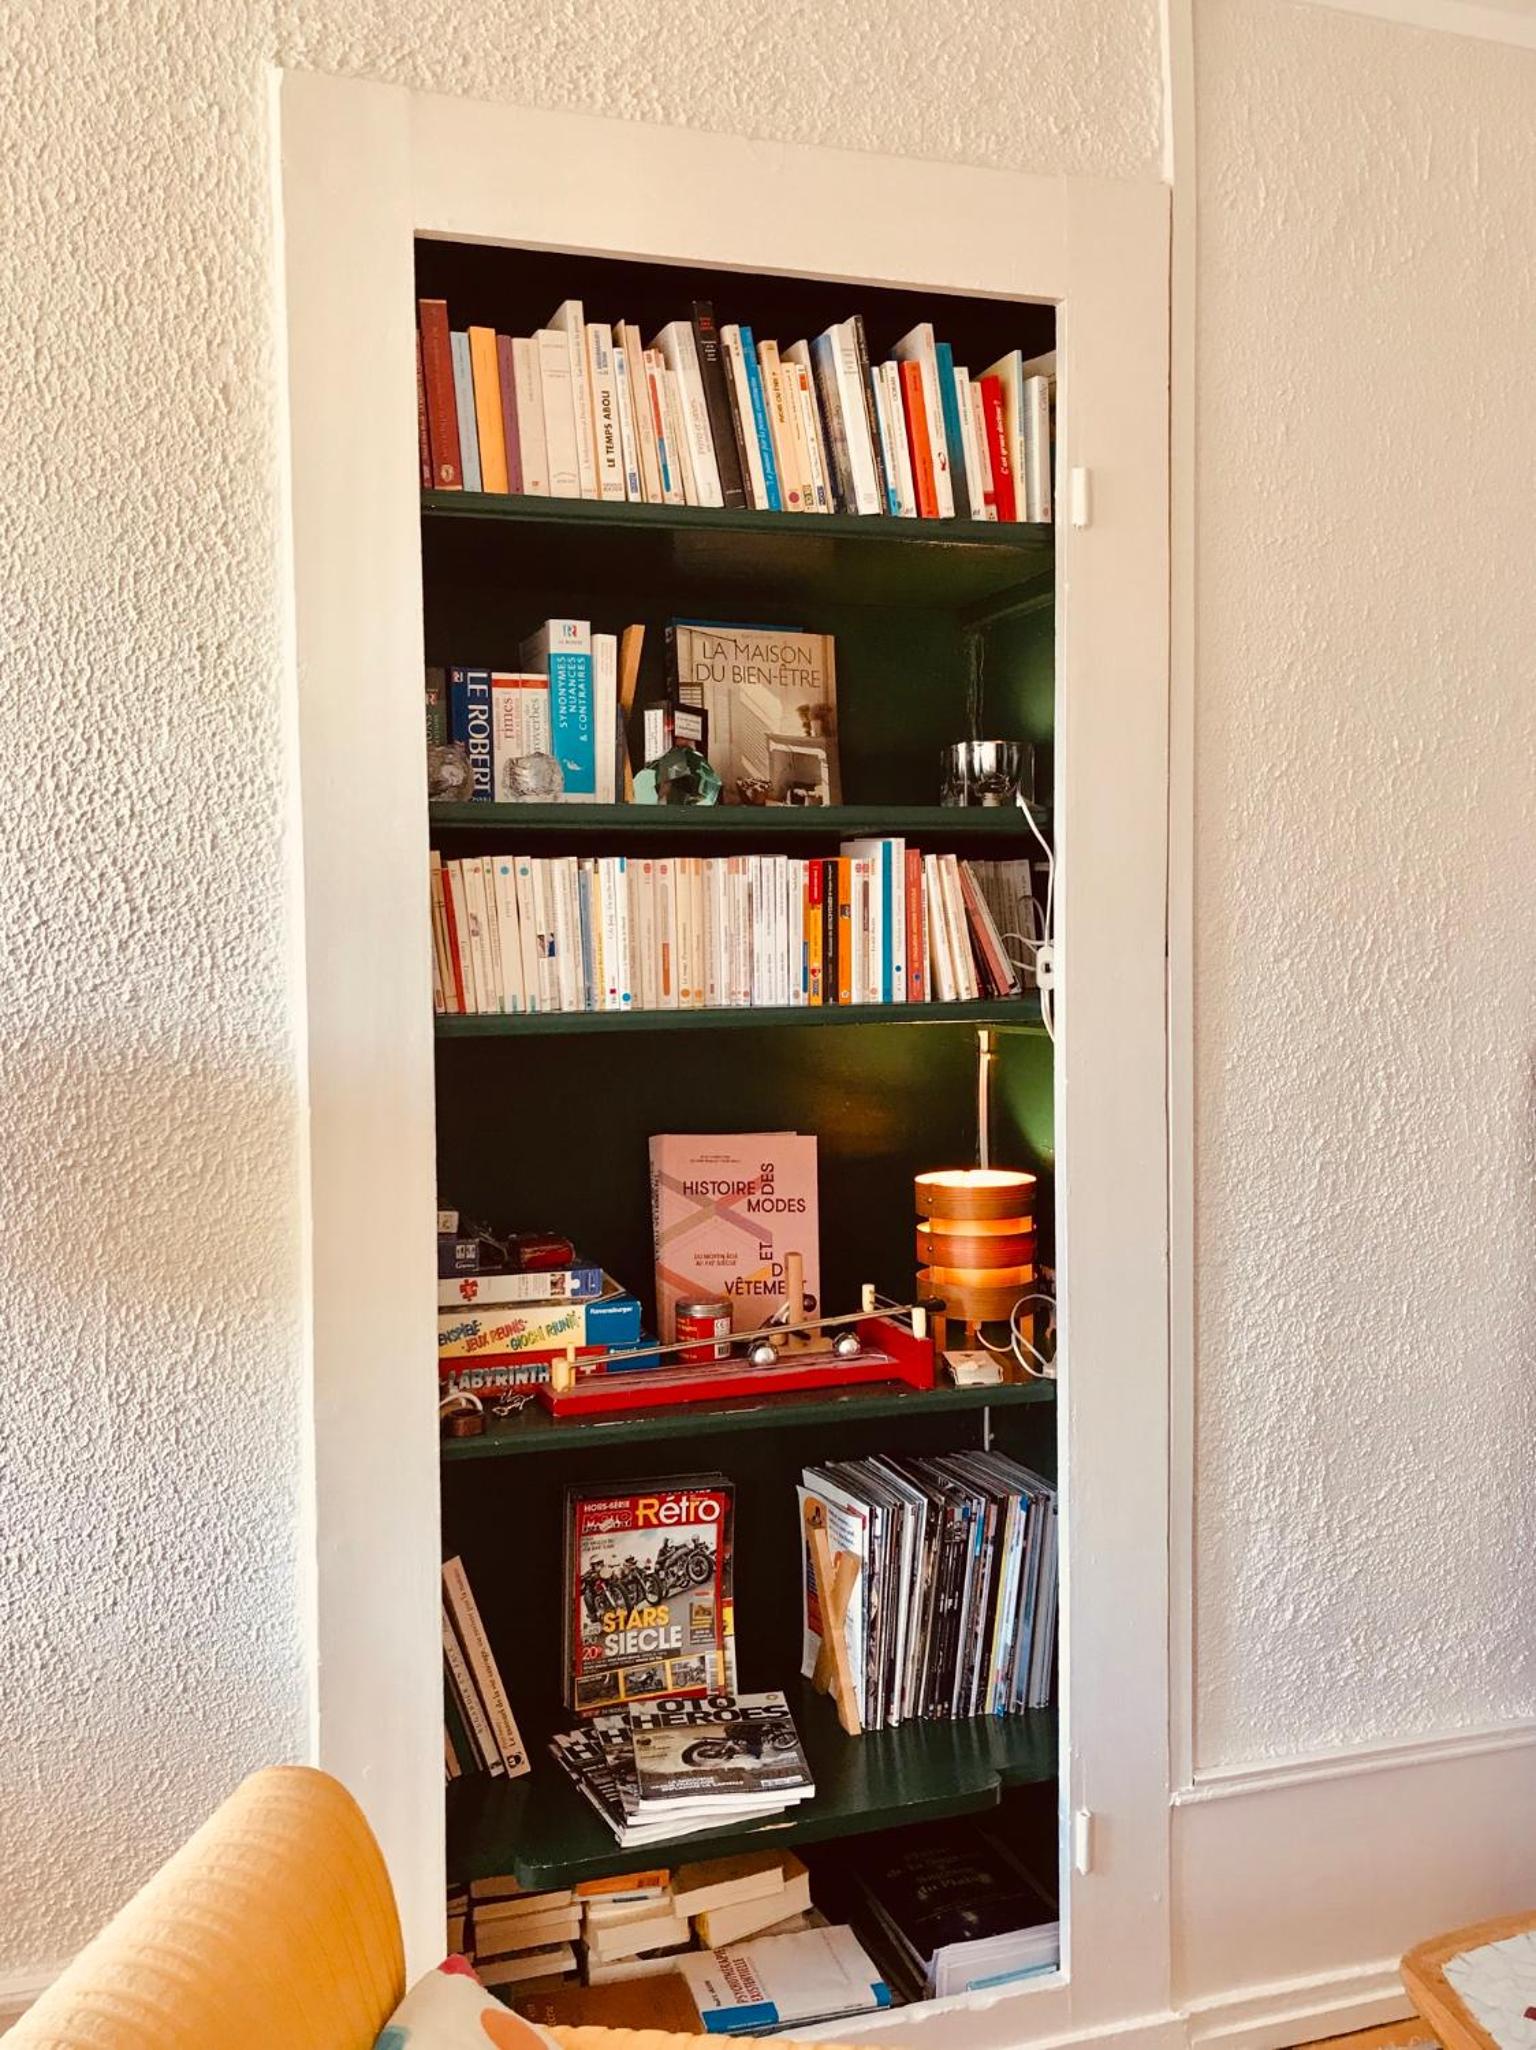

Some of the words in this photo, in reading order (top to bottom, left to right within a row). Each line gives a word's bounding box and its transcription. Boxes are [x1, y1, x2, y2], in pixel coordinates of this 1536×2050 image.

[600, 390, 612, 416] ABOLI
[995, 408, 1007, 430] docteur
[604, 420, 616, 450] TEMPS
[606, 452, 616, 468] LE
[702, 641, 728, 660] LA
[734, 640, 813, 665] MAISON
[467, 672, 489, 698] LE
[567, 656, 577, 713] NUANCES
[696, 663, 726, 683] DU
[732, 662, 822, 689] BIEN-ÊTRE
[557, 656, 568, 729] SYNONYMES
[577, 657, 588, 730] CONTRAIRES
[504, 697, 515, 740] rimes
[467, 705, 491, 793] ROBERT
[683, 1180, 757, 1196] HISTOIRE
[761, 1162, 775, 1195] DES
[747, 1198, 806, 1213] MODES
[759, 1241, 773, 1260] ET
[589, 1305, 634, 1315] Ravensburger
[447, 1362, 550, 1396] LABYRINTH
[635, 1494, 721, 1527] Rétro
[602, 1604, 670, 1633] STARS
[632, 1704, 790, 1730] HEROES
